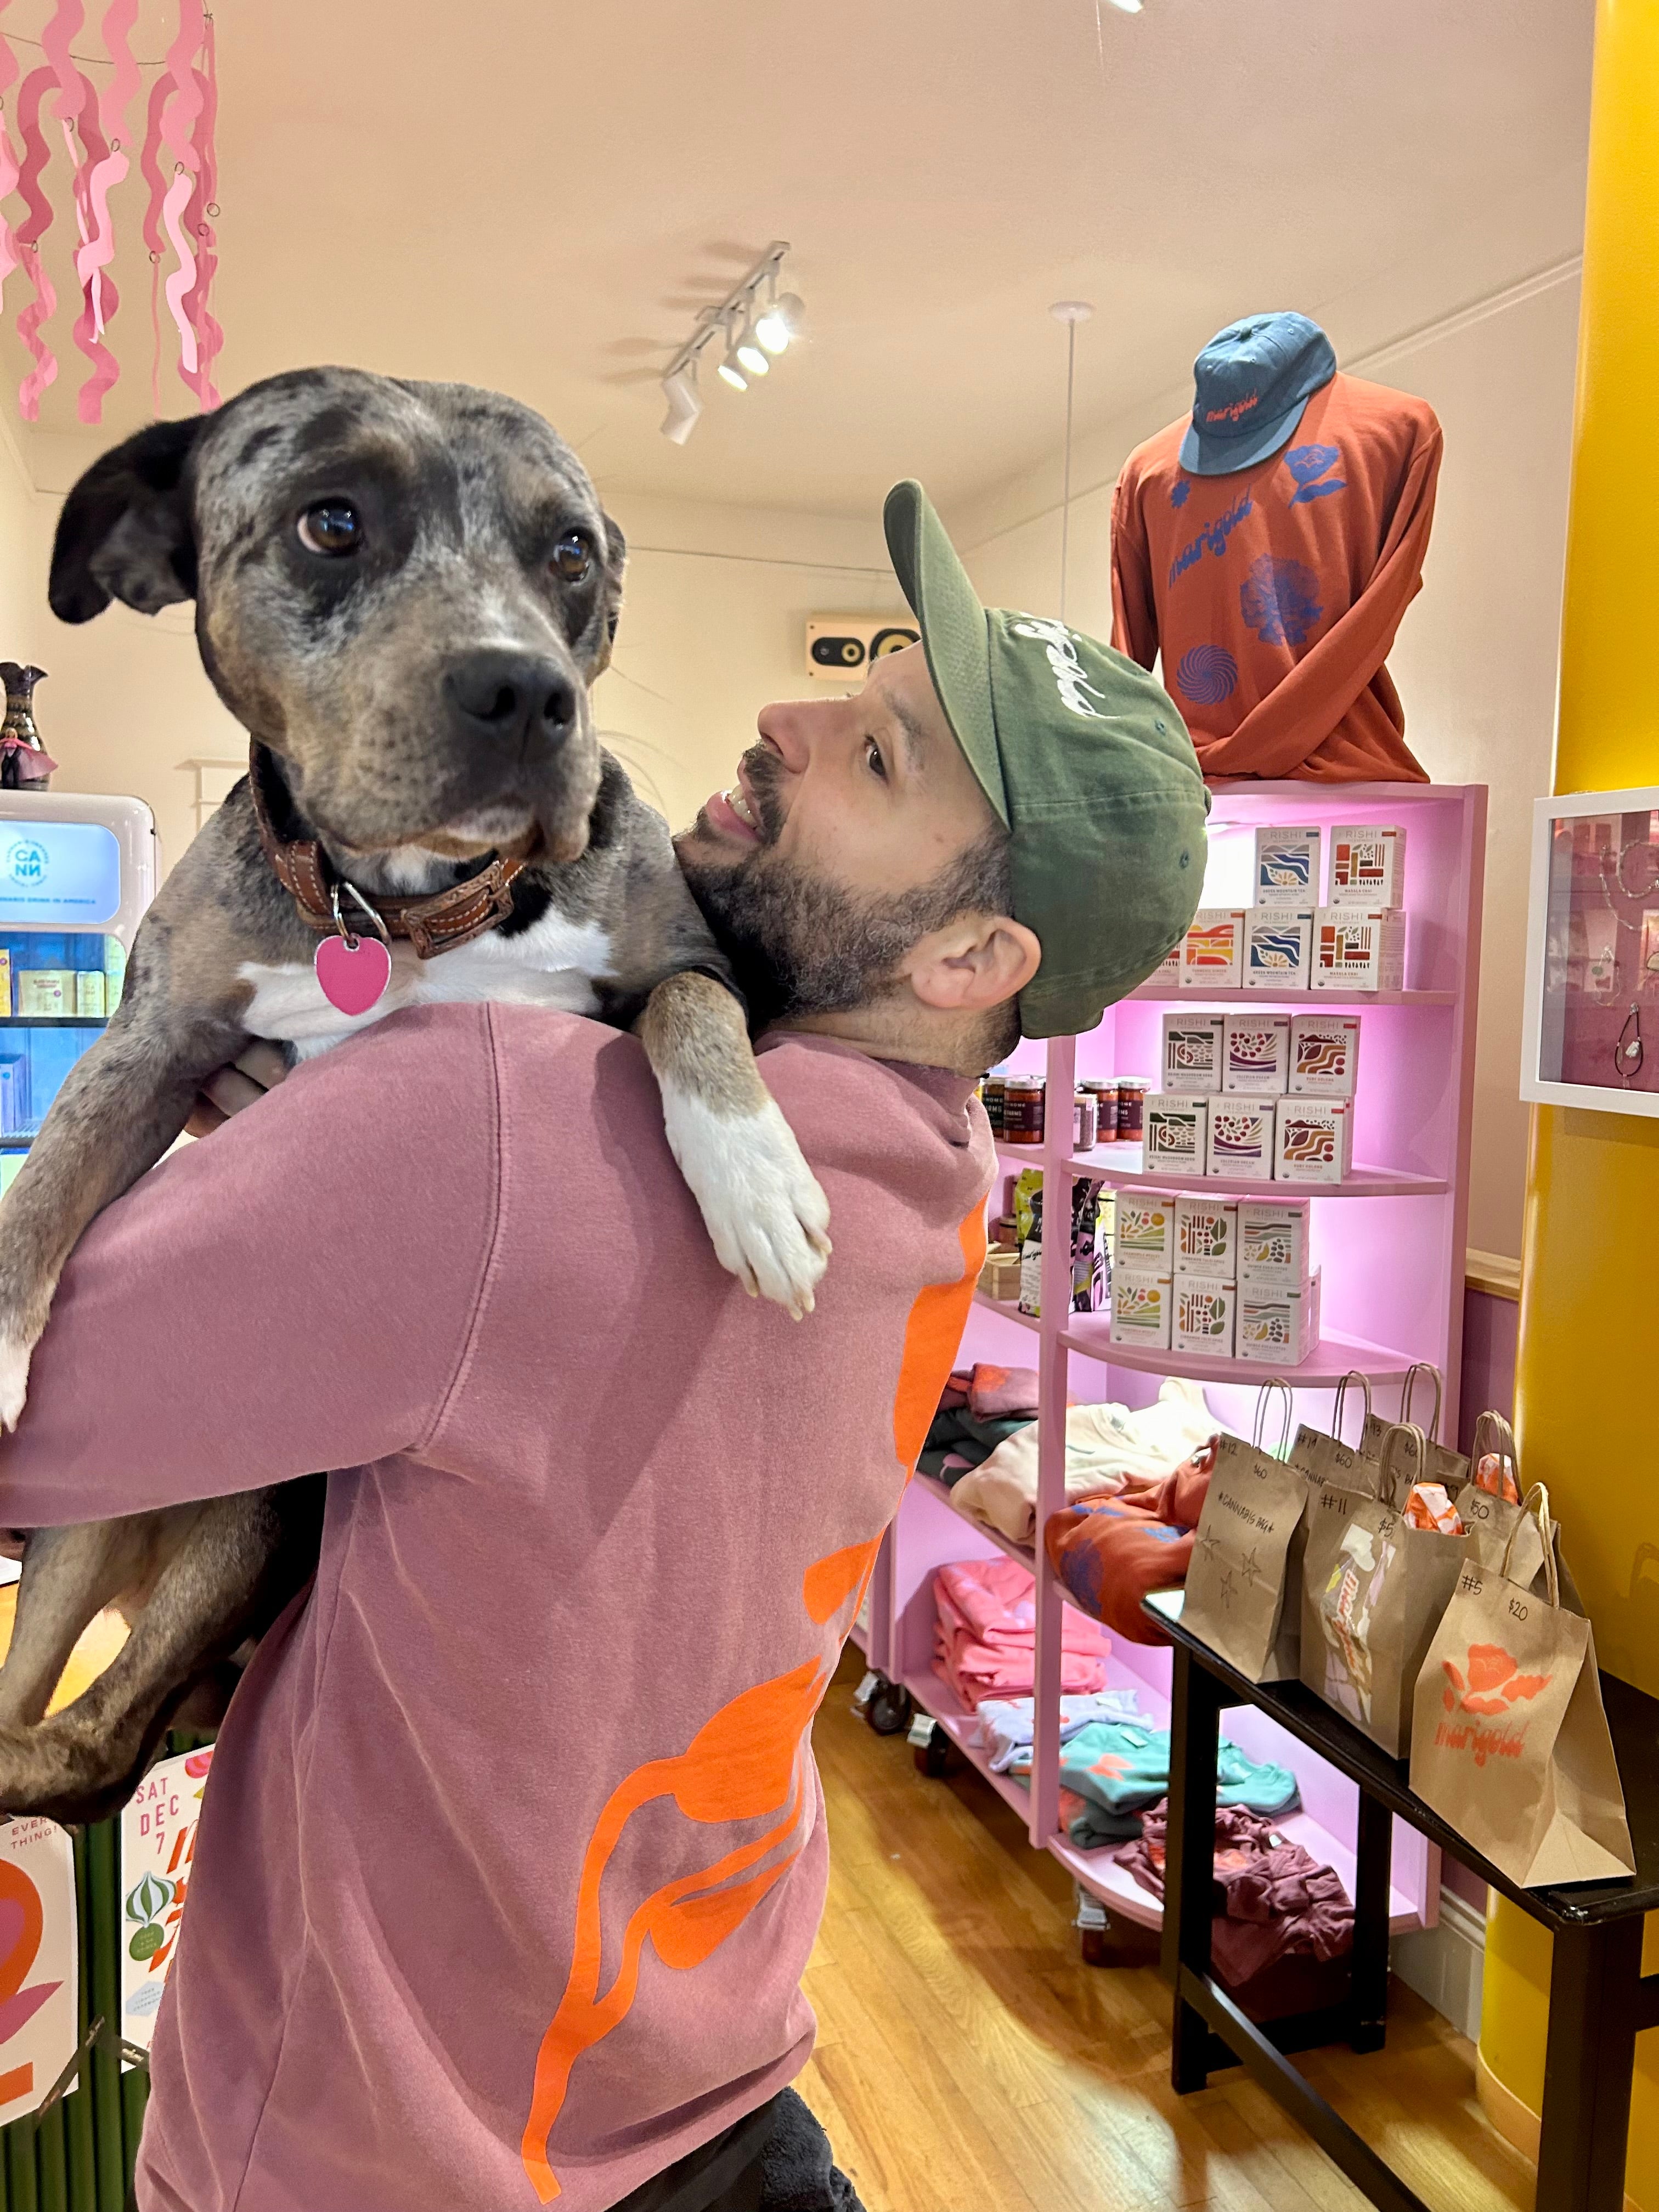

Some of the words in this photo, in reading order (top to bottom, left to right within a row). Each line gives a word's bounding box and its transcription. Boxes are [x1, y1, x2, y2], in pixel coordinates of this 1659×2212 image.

[1270, 831, 1301, 839] RISHI
[1261, 912, 1293, 921] RISHI
[1308, 1021, 1339, 1030] RISHI
[1158, 1099, 1188, 1108] RISHI
[1224, 1103, 1254, 1111] RISHI
[1294, 1105, 1326, 1115] RISHI
[1128, 1198, 1157, 1207] RISHI
[1189, 1201, 1221, 1211] RISHI
[1253, 1209, 1283, 1218] RISHI
[1125, 1275, 1153, 1284] RISHI
[1188, 1281, 1218, 1290] RISHI
[1252, 1288, 1283, 1297] RISHI
[1404, 1441, 1418, 1458] $6
[1335, 1452, 1352, 1469] $60
[1320, 1493, 1347, 1515] #11
[1470, 1498, 1489, 1520] $50
[1462, 1575, 1483, 1595] #5
[1509, 1598, 1528, 1621] $20
[1434, 1720, 1530, 1769] marigold
[136, 1778, 168, 1804] SAT
[140, 1795, 179, 1836] DEC
[12, 1817, 48, 1836] EVER
[11, 1825, 57, 1849] THING!
[156, 1832, 165, 1855] 7
